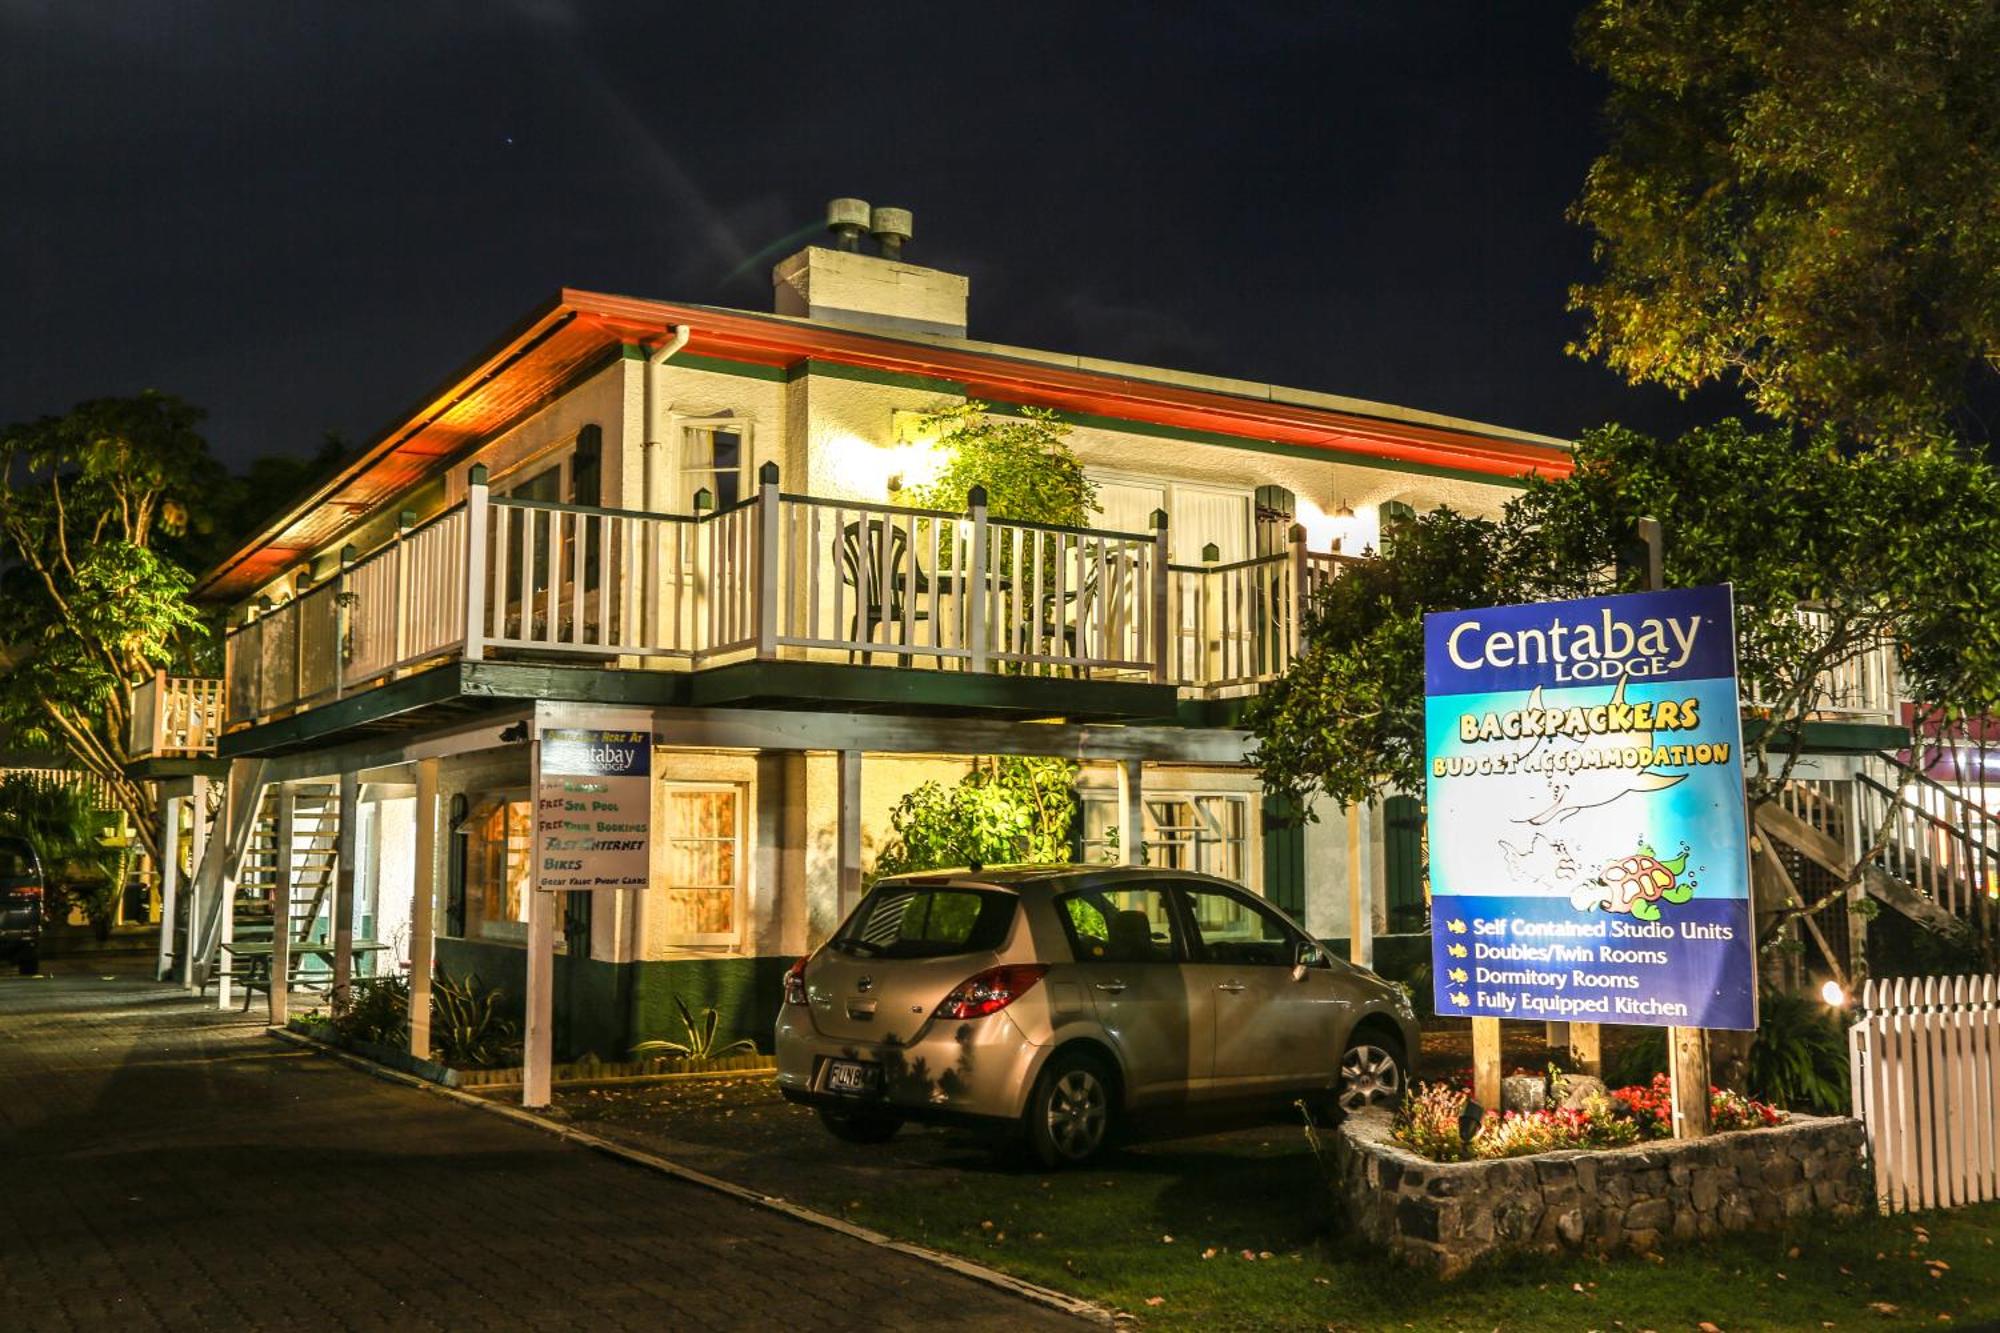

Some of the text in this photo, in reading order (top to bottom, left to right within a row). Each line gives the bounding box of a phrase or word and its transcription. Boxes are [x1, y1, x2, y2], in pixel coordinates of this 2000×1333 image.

[1448, 608, 1701, 670] Centabay
[1555, 657, 1670, 682] LODGE
[1459, 698, 1700, 743] BACKPACKERS
[595, 763, 626, 772] ODGE
[1432, 743, 1730, 778] BUDGET ACCOMMODATION
[1473, 919, 1733, 940] Self Contained Studio Units
[1475, 943, 1668, 965] Doubles/Twin Rooms
[1476, 967, 1640, 990] Dormitory Rooms
[1477, 991, 1688, 1017] Fully Equipped Kitchen
[831, 1065, 874, 1087] FUN8
